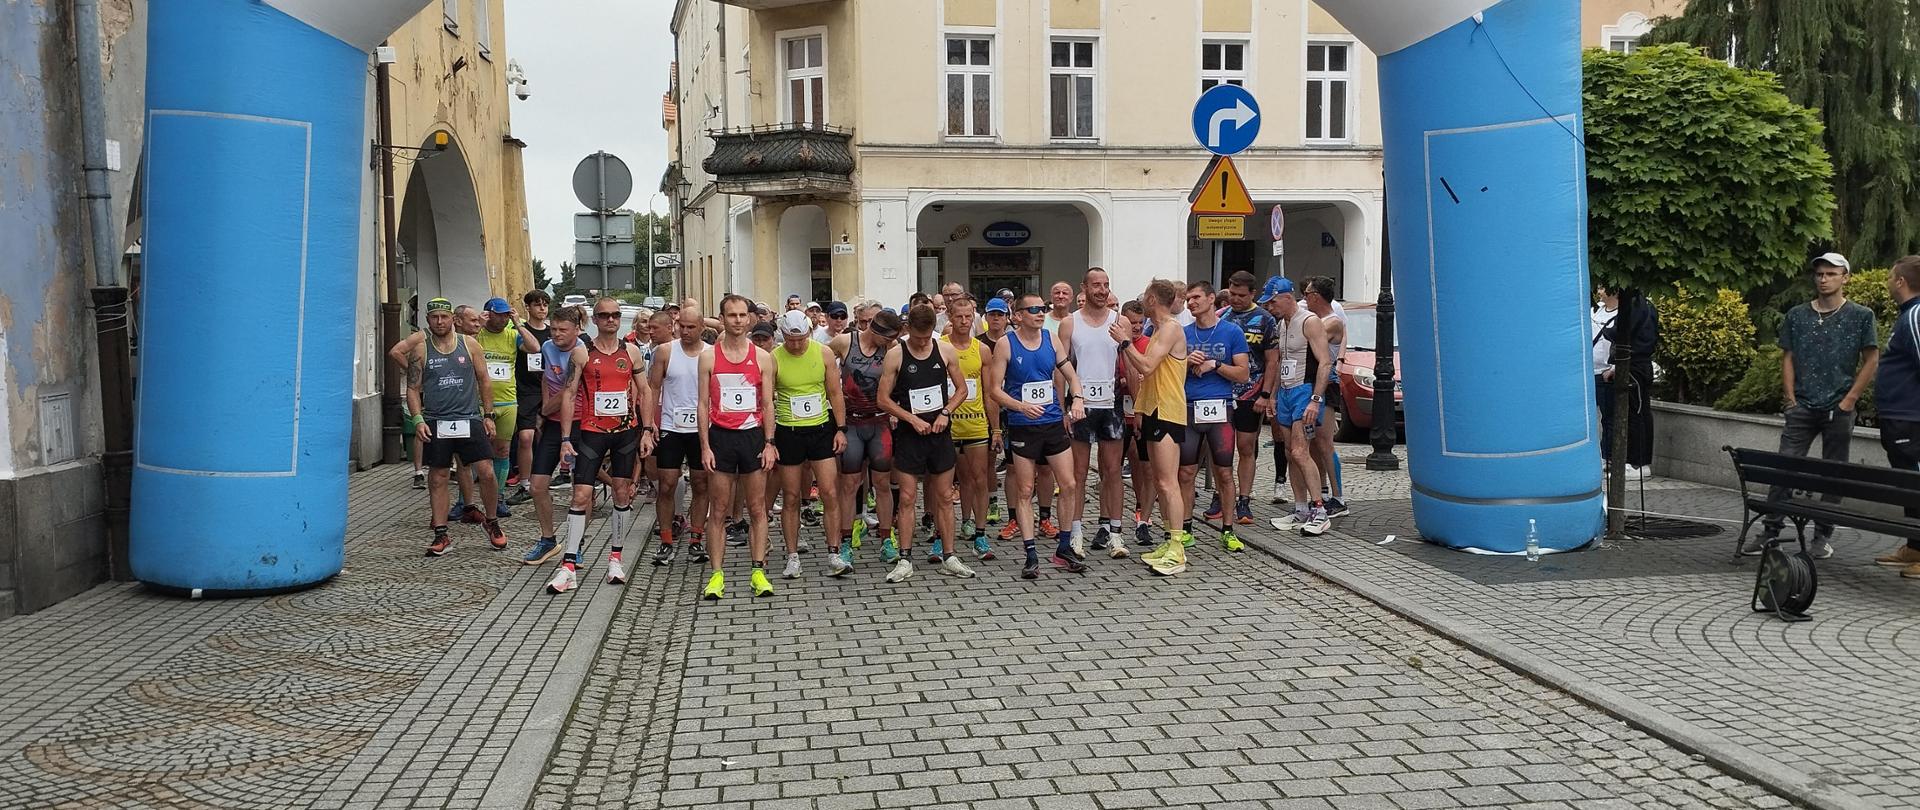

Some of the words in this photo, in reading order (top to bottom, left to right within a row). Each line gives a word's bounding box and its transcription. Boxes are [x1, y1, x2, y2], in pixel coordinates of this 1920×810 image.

[535, 358, 541, 366] 5
[494, 367, 505, 377] 41
[1031, 388, 1046, 400] 88
[1090, 386, 1103, 397] 31
[604, 398, 620, 410] 22
[734, 393, 743, 405] 9
[924, 394, 932, 405] 5
[803, 401, 811, 413] 6
[1203, 406, 1218, 417] 84
[682, 413, 696, 424] 75
[449, 421, 458, 432] 4
